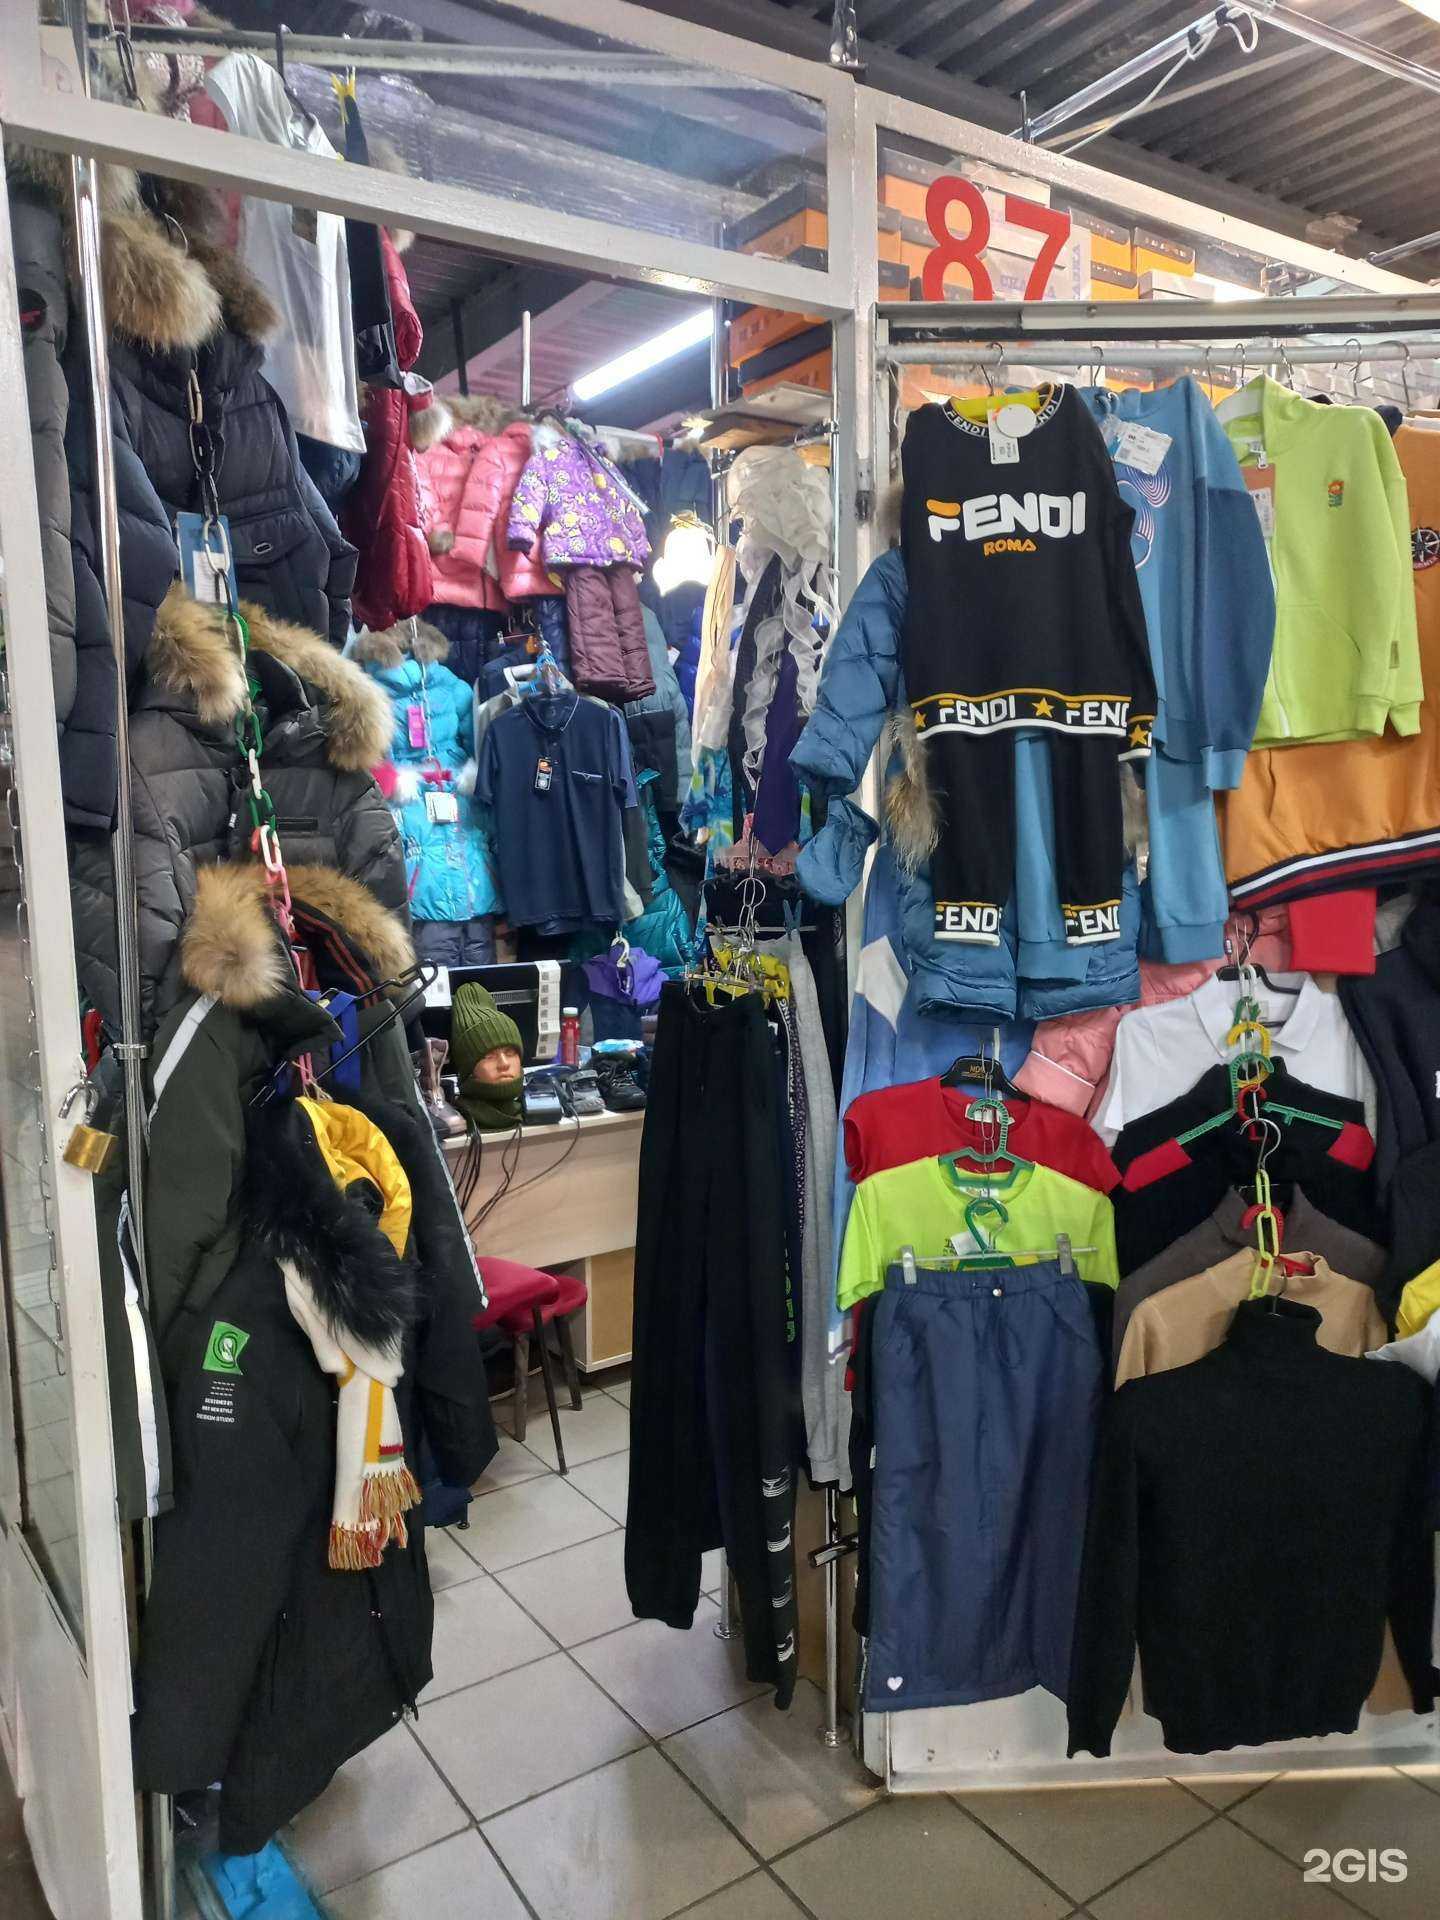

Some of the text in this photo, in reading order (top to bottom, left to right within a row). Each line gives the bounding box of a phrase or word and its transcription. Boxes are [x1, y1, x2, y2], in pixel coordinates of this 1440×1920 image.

[923, 175, 1071, 301] 87
[946, 410, 986, 437] FENDI
[926, 491, 1086, 542] FENDI
[983, 538, 1037, 557] ROMA
[938, 695, 1016, 726] FENDI
